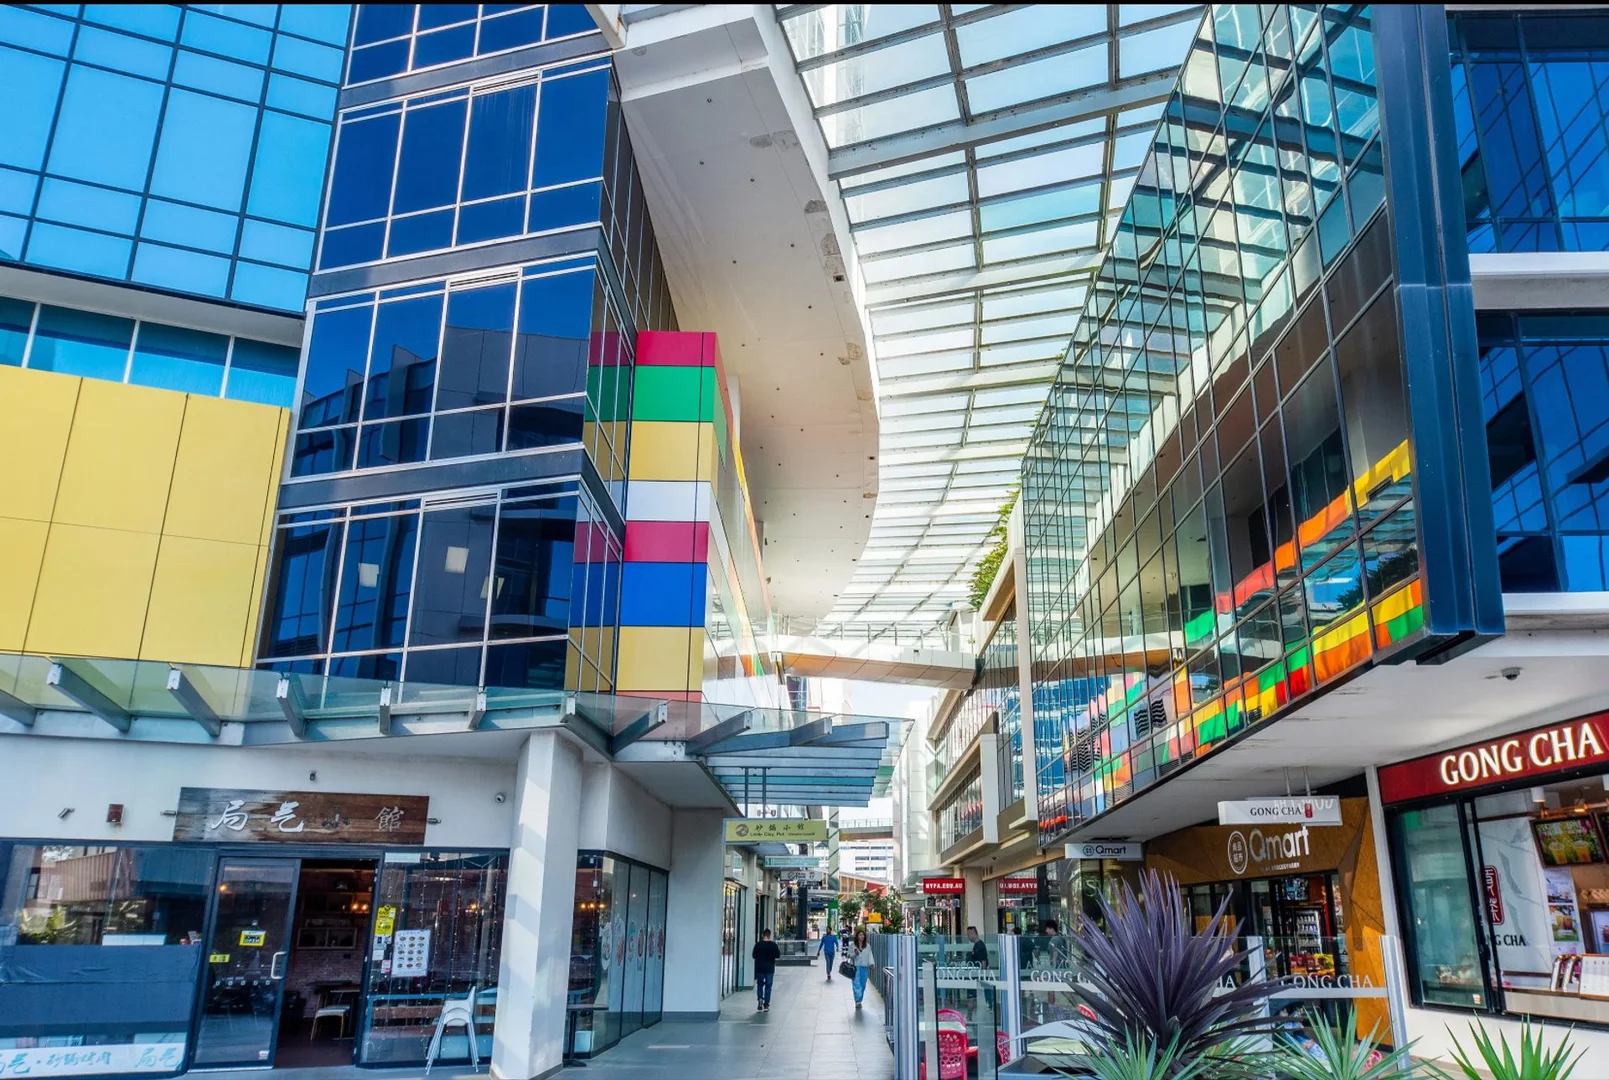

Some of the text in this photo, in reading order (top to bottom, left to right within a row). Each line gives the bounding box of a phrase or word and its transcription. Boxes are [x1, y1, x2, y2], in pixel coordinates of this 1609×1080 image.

[1440, 722, 1604, 786] GONG CHA
[1250, 807, 1279, 817] GONG
[1281, 806, 1302, 816] CHA
[1095, 845, 1127, 855] Qmart
[1249, 825, 1310, 863] Qmart
[1503, 934, 1527, 947] CHA
[936, 969, 997, 983] ONG CHA
[1030, 969, 1073, 983] GONG
[1337, 974, 1374, 988] CHA
